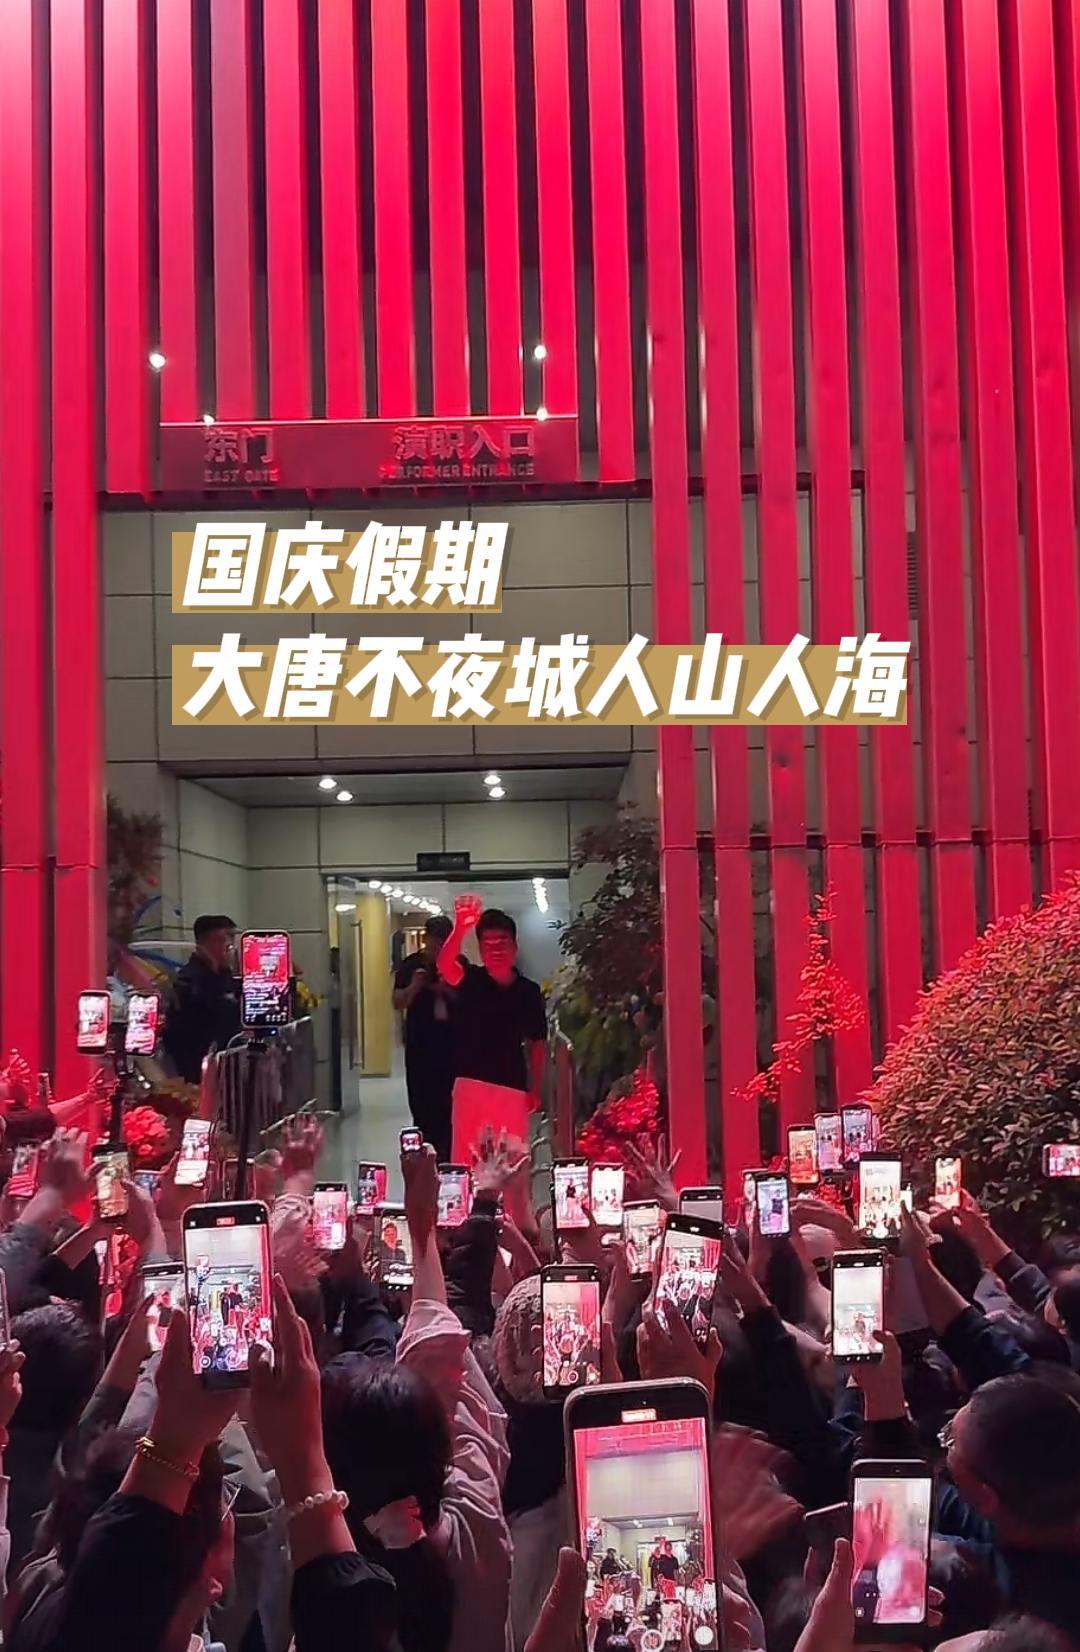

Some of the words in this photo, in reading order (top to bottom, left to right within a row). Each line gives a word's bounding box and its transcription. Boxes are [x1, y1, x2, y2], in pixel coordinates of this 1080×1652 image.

[203, 426, 274, 463] 东门
[392, 424, 536, 460] 演职入口
[204, 469, 240, 482] EAST
